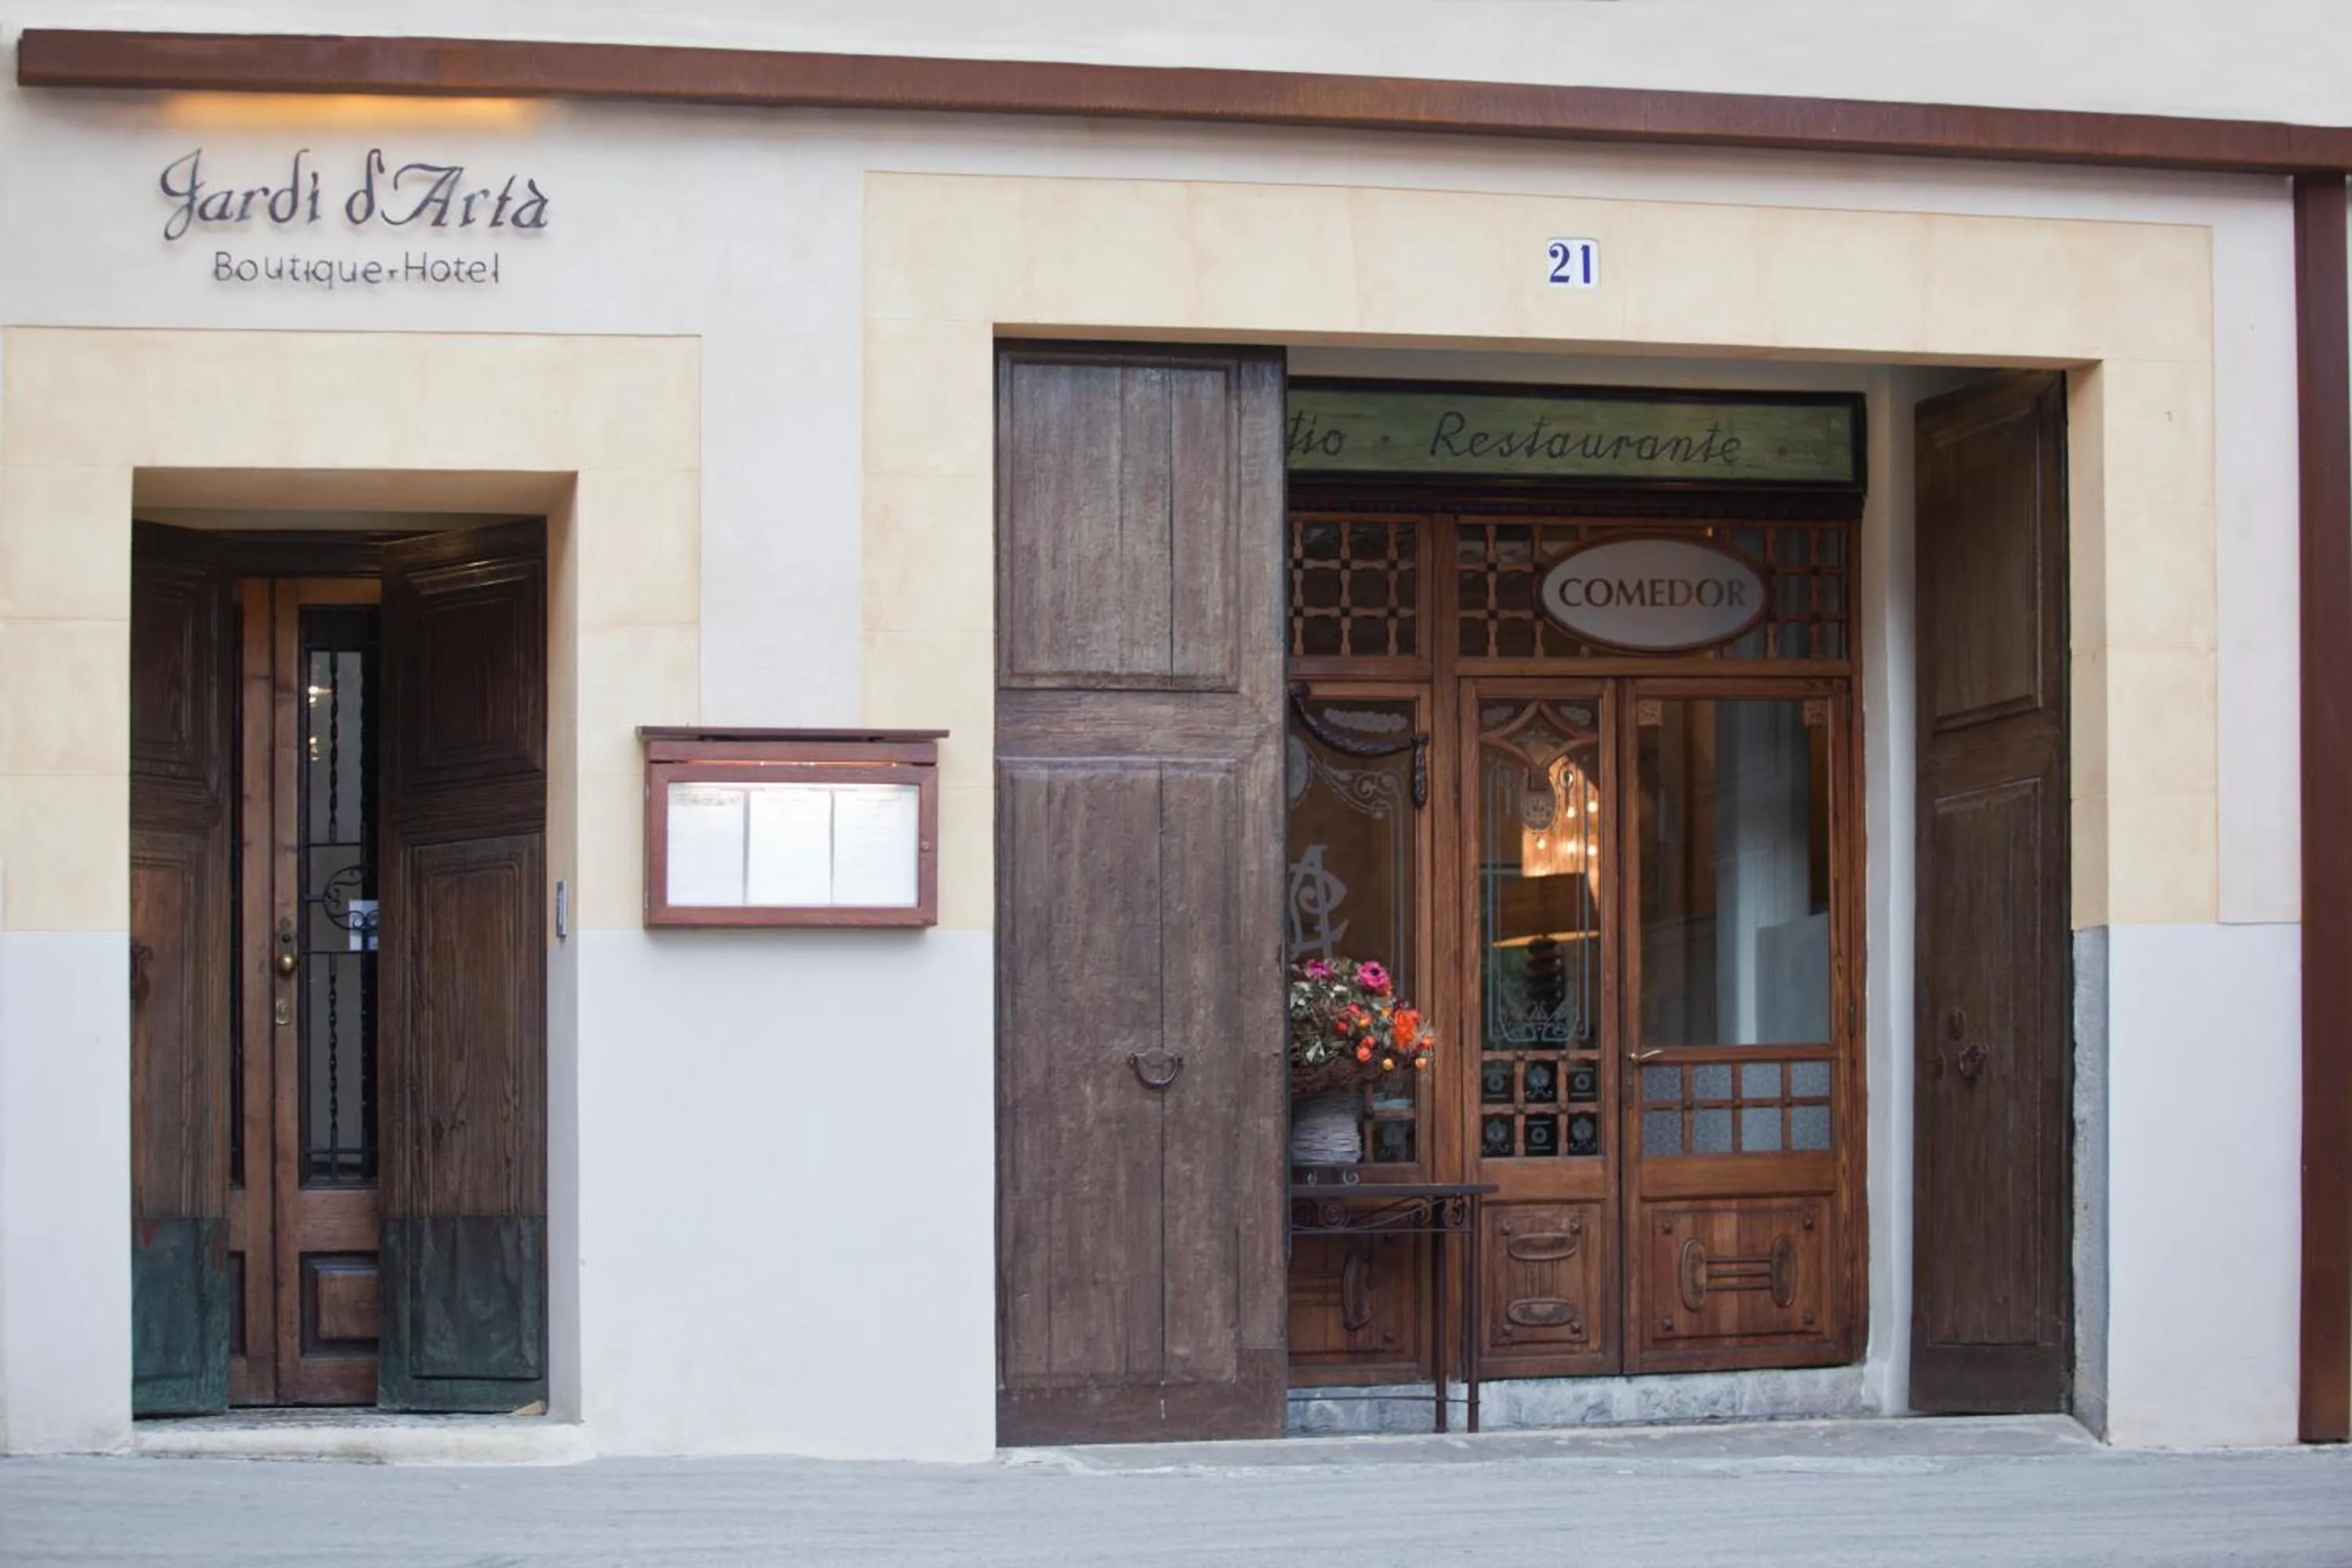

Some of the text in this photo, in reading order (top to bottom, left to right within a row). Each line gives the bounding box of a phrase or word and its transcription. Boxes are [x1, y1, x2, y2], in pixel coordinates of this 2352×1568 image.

[1548, 242, 1591, 284] 21
[1429, 412, 1742, 463] Restaurante
[1559, 577, 1747, 608] COMEDOR
